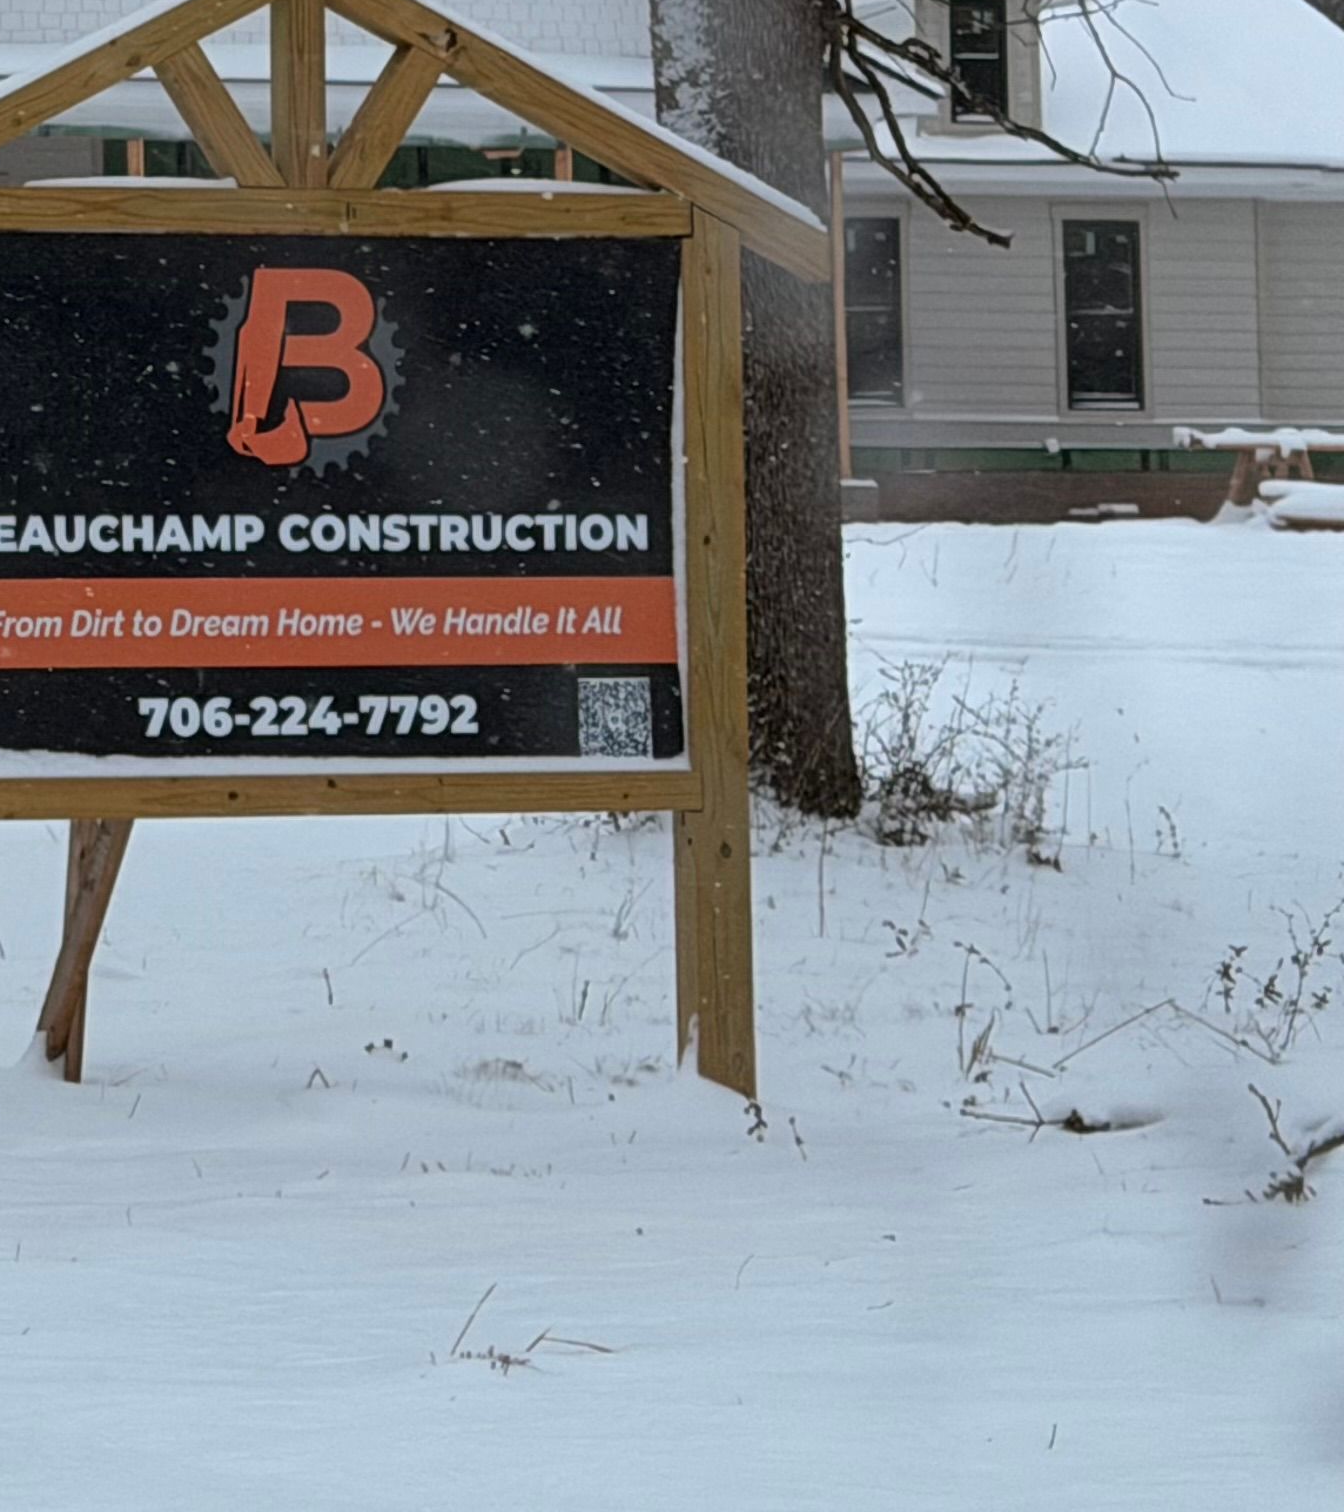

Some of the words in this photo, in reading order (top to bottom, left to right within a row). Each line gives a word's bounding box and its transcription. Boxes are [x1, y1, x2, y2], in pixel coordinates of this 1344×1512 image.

[226, 268, 384, 466] B
[278, 513, 650, 552] CONSTRUCTION
[70, 608, 125, 639] Dirt
[132, 608, 163, 638] to
[170, 607, 270, 638] Dream
[277, 607, 364, 637] Home
[390, 607, 439, 636] We
[443, 605, 550, 636] Handle
[556, 605, 577, 635] It
[582, 605, 623, 636] All
[138, 694, 480, 738] 706-224-7792
